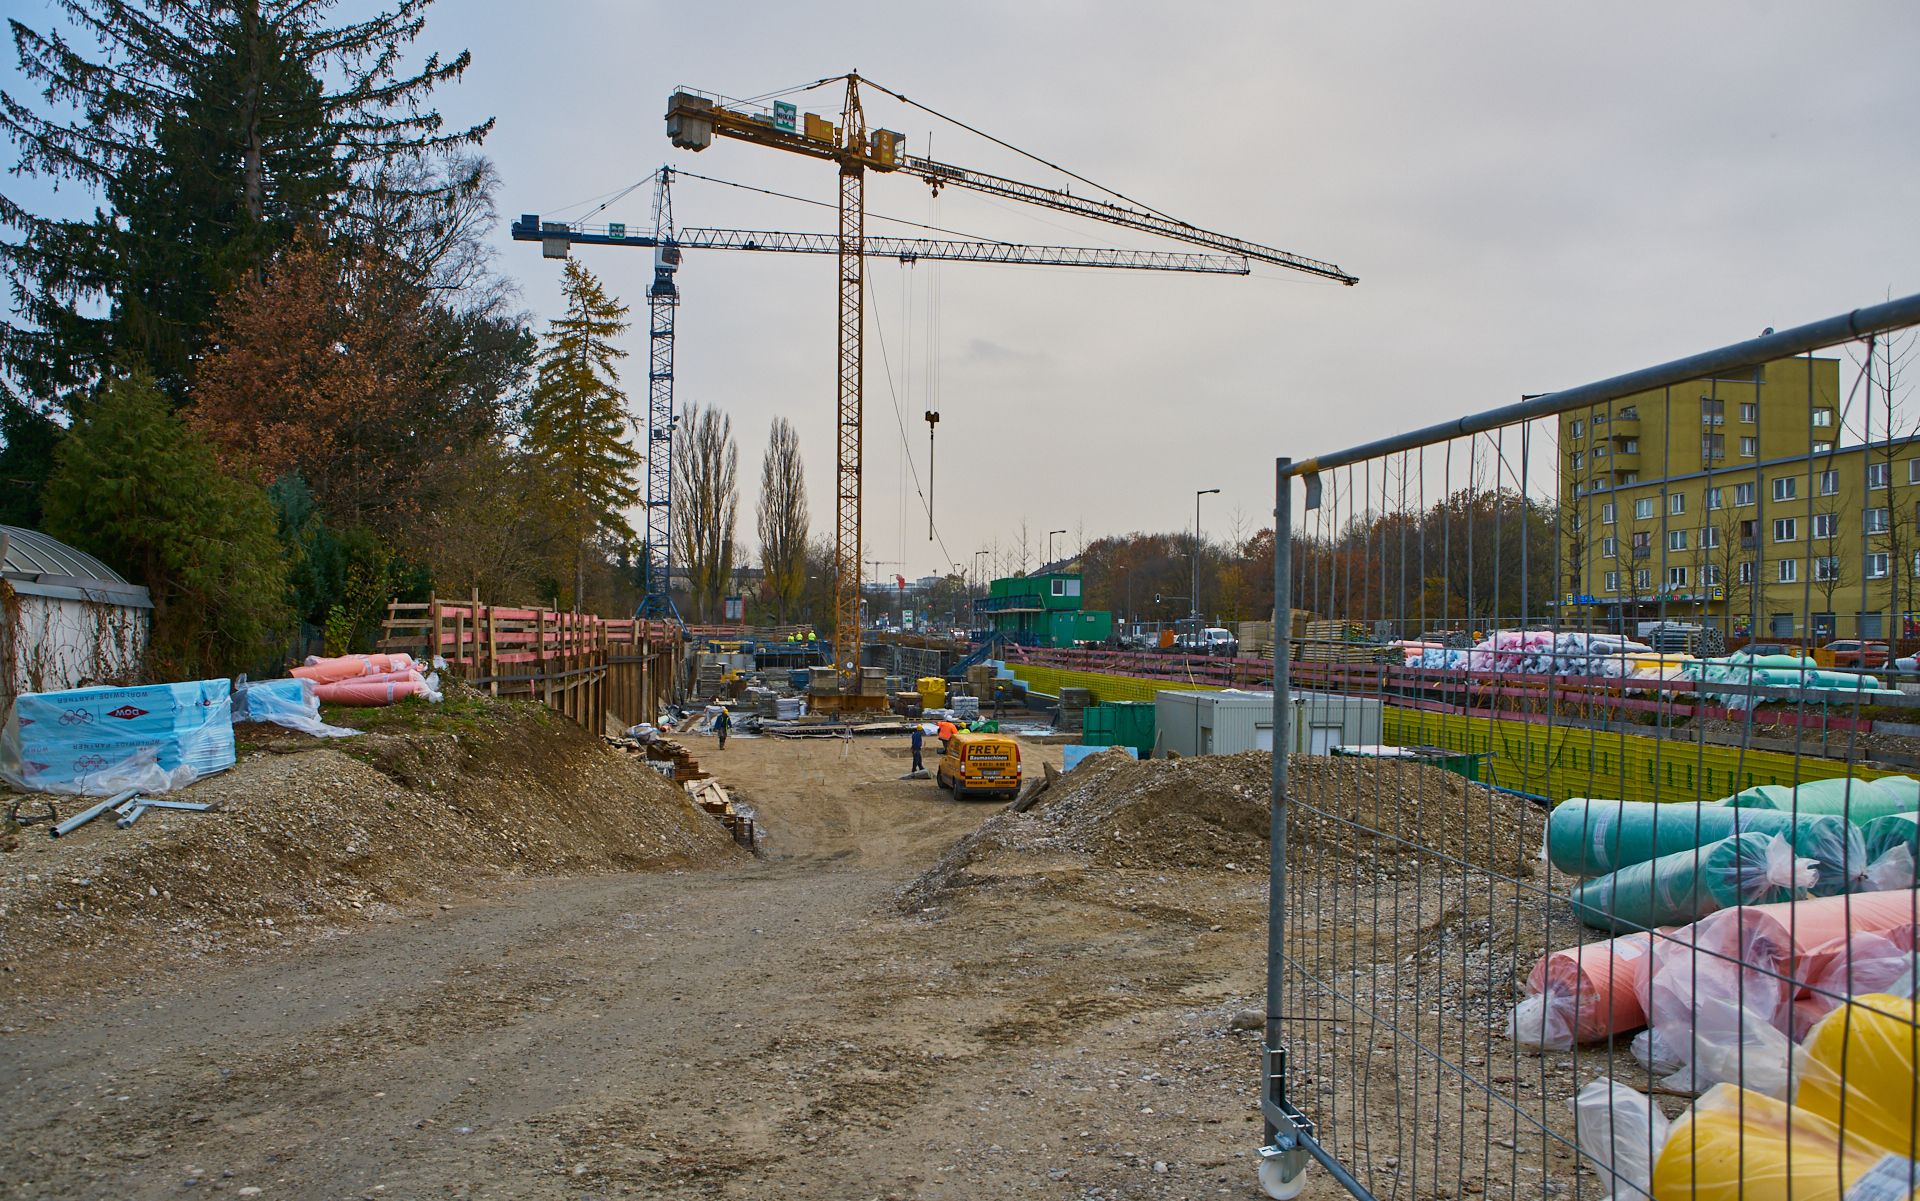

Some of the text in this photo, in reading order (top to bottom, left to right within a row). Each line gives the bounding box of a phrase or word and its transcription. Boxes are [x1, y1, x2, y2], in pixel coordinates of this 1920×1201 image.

[58, 691, 148, 704] WORLDWIDE PARTNER
[115, 708, 140, 717] DOW
[116, 739, 160, 748] WORLDWIDE
[968, 745, 1000, 754] FREY
